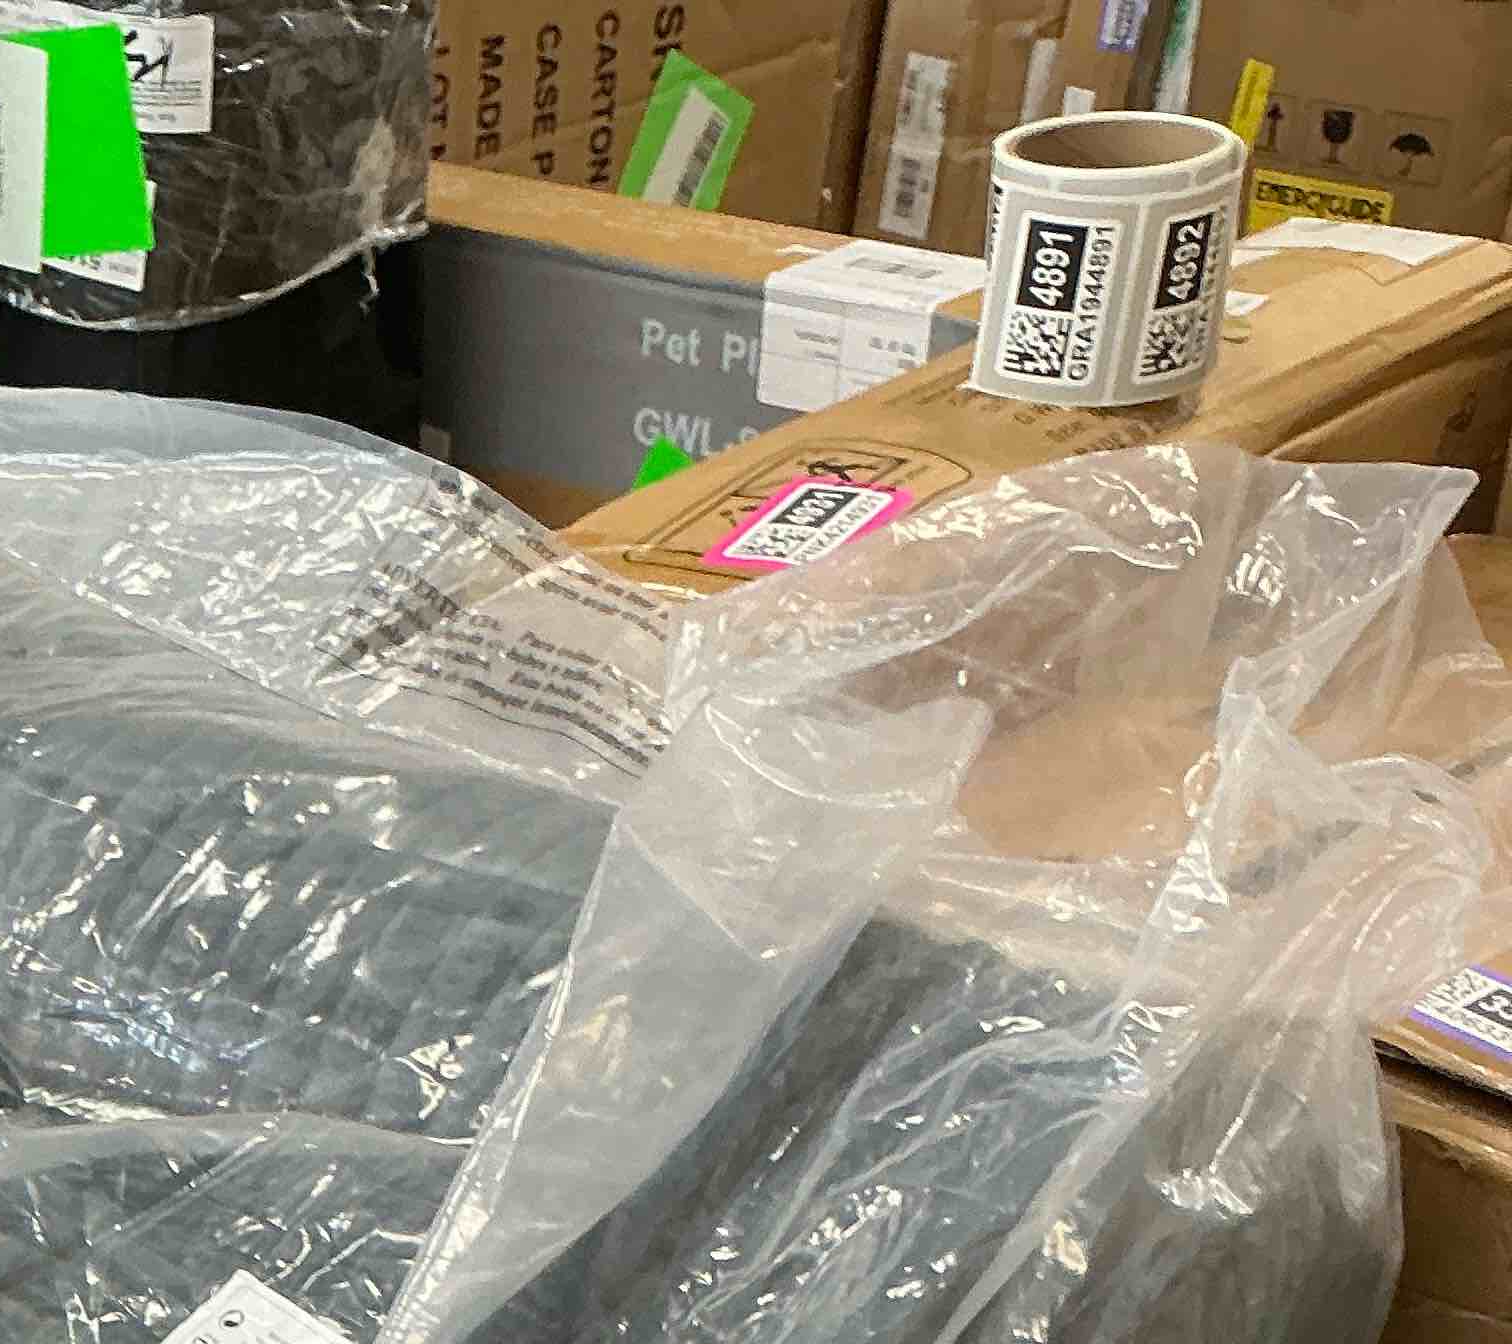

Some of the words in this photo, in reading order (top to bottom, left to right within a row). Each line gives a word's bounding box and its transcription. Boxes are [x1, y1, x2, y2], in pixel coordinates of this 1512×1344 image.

[475, 34, 505, 160] MADE
[532, 24, 563, 139] CASE
[586, 9, 621, 185] CARTON
[1027, 229, 1076, 307] 4891
[1166, 220, 1206, 300] 4892
[639, 317, 702, 367] Pet
